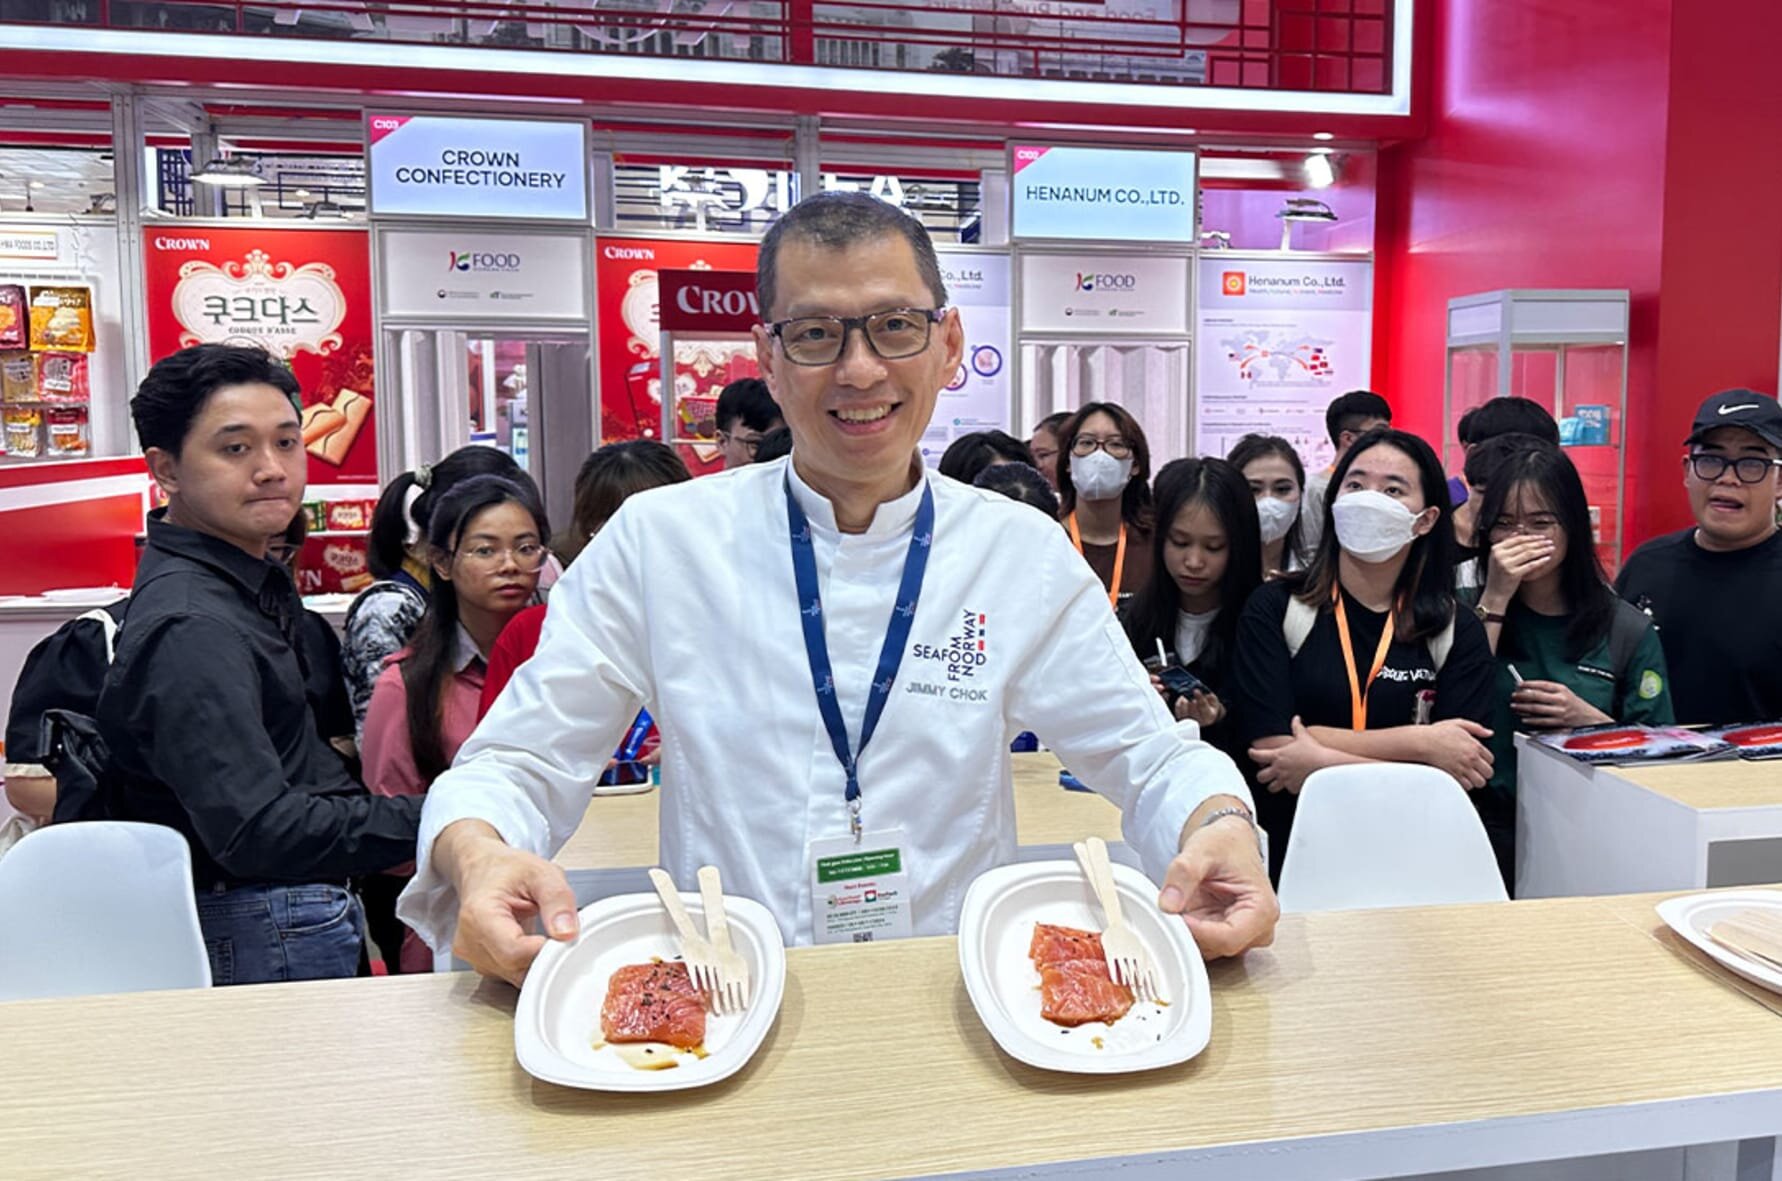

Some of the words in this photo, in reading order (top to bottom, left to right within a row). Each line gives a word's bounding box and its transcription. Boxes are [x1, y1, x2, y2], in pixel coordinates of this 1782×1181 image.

[373, 119, 399, 130] C103
[441, 149, 520, 168] CROWN
[395, 167, 566, 189] CONFECTIONERY
[1026, 186, 1112, 203] HENANUM
[155, 236, 210, 251] CROWN
[472, 253, 520, 268] FOOD
[604, 245, 655, 261] CROWN
[1095, 273, 1136, 288] FOOD
[1248, 275, 1300, 287] Henanum
[202, 294, 321, 325] 쿠크다스
[961, 608, 976, 677] NORWAY
[913, 643, 987, 666] SEAFOOD
[947, 636, 962, 682] FROM
[905, 682, 946, 697] JIMMY
[949, 687, 988, 701] CHOK
